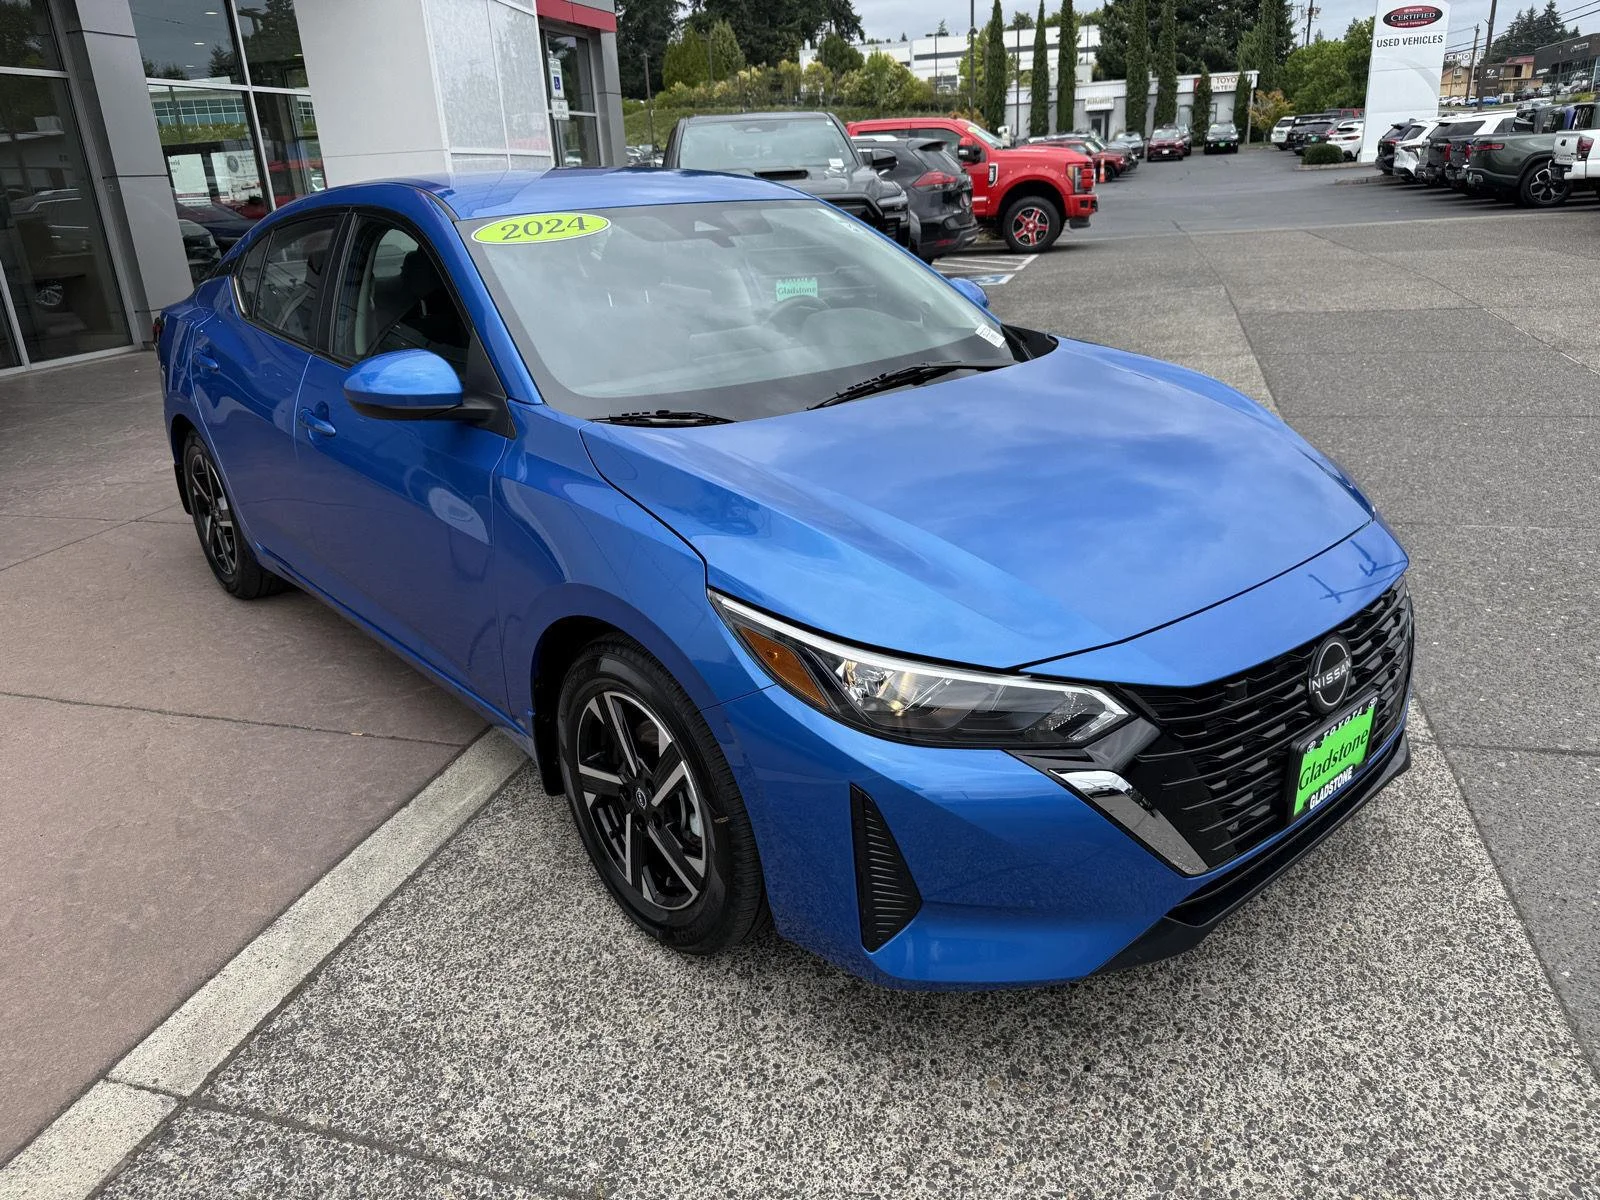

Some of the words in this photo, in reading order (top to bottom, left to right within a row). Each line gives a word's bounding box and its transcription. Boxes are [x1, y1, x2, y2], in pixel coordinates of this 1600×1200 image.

[1391, 12, 1436, 22] CERTIFIED
[1376, 38, 1400, 48] USED
[1402, 34, 1443, 46] VEHICLES
[501, 216, 589, 240] 2024
[777, 285, 817, 295] Gladstone
[1311, 660, 1352, 692] NISSAN
[1322, 706, 1363, 742] TOYOTA
[1298, 729, 1369, 791] Gladstone
[1309, 765, 1353, 810] GLADSTONE
